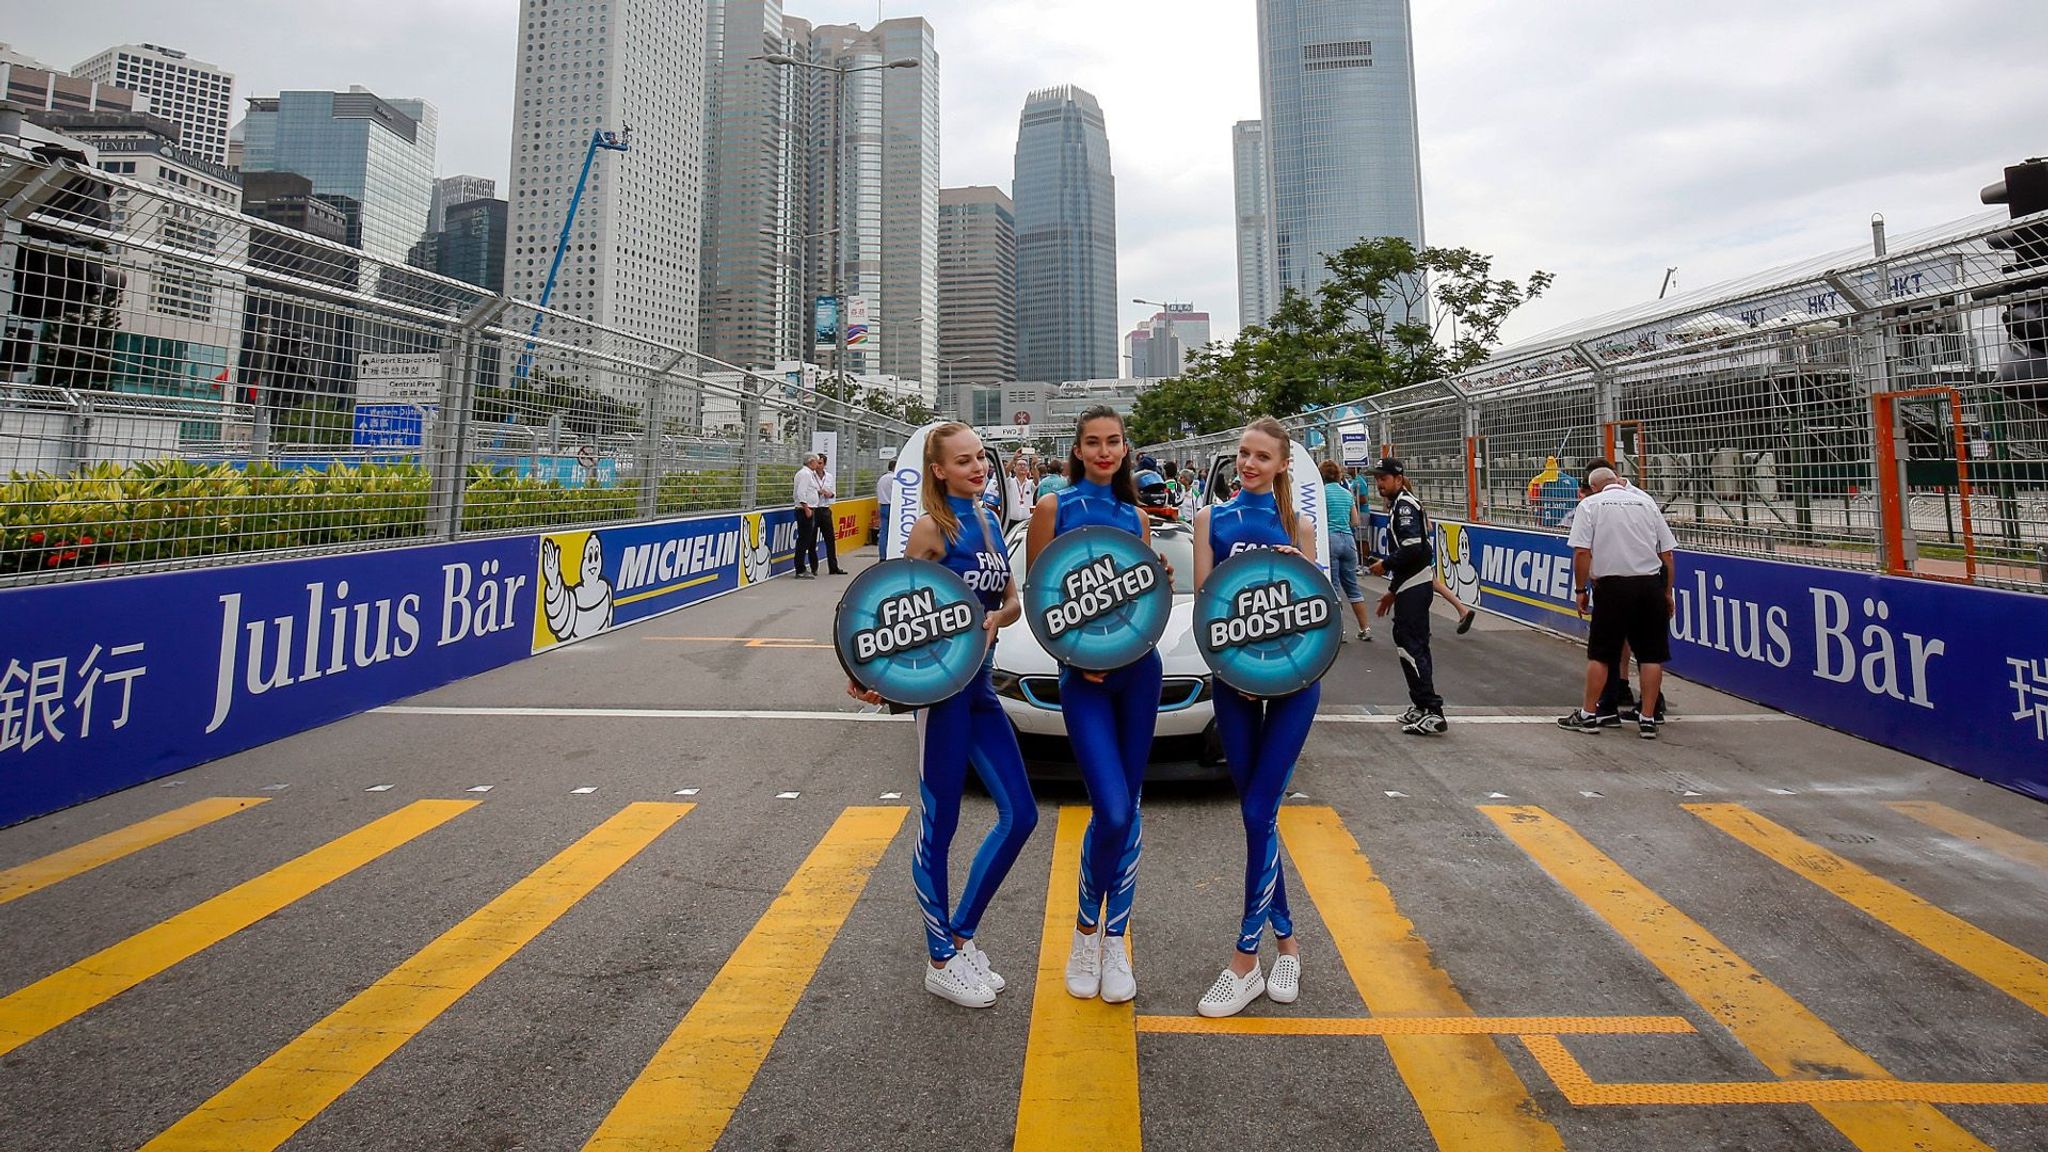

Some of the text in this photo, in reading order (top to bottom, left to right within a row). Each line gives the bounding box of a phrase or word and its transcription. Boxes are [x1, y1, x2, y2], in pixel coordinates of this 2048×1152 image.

[1807, 291, 1838, 315] HKT
[616, 530, 739, 592] MICHELIN
[963, 569, 1009, 592] BOOS
[975, 551, 1007, 571] FAN
[1066, 558, 1115, 599] FAN
[883, 591, 933, 626] FAN
[1046, 565, 1155, 635] BOOSTED
[1210, 598, 1328, 647] BOOSTED
[1238, 583, 1288, 617] FAN
[205, 558, 526, 734] Julius Bär
[857, 604, 972, 659] BOOSTED
[1669, 569, 1945, 709] ulius Bär
[0, 642, 147, 753] 銀行
